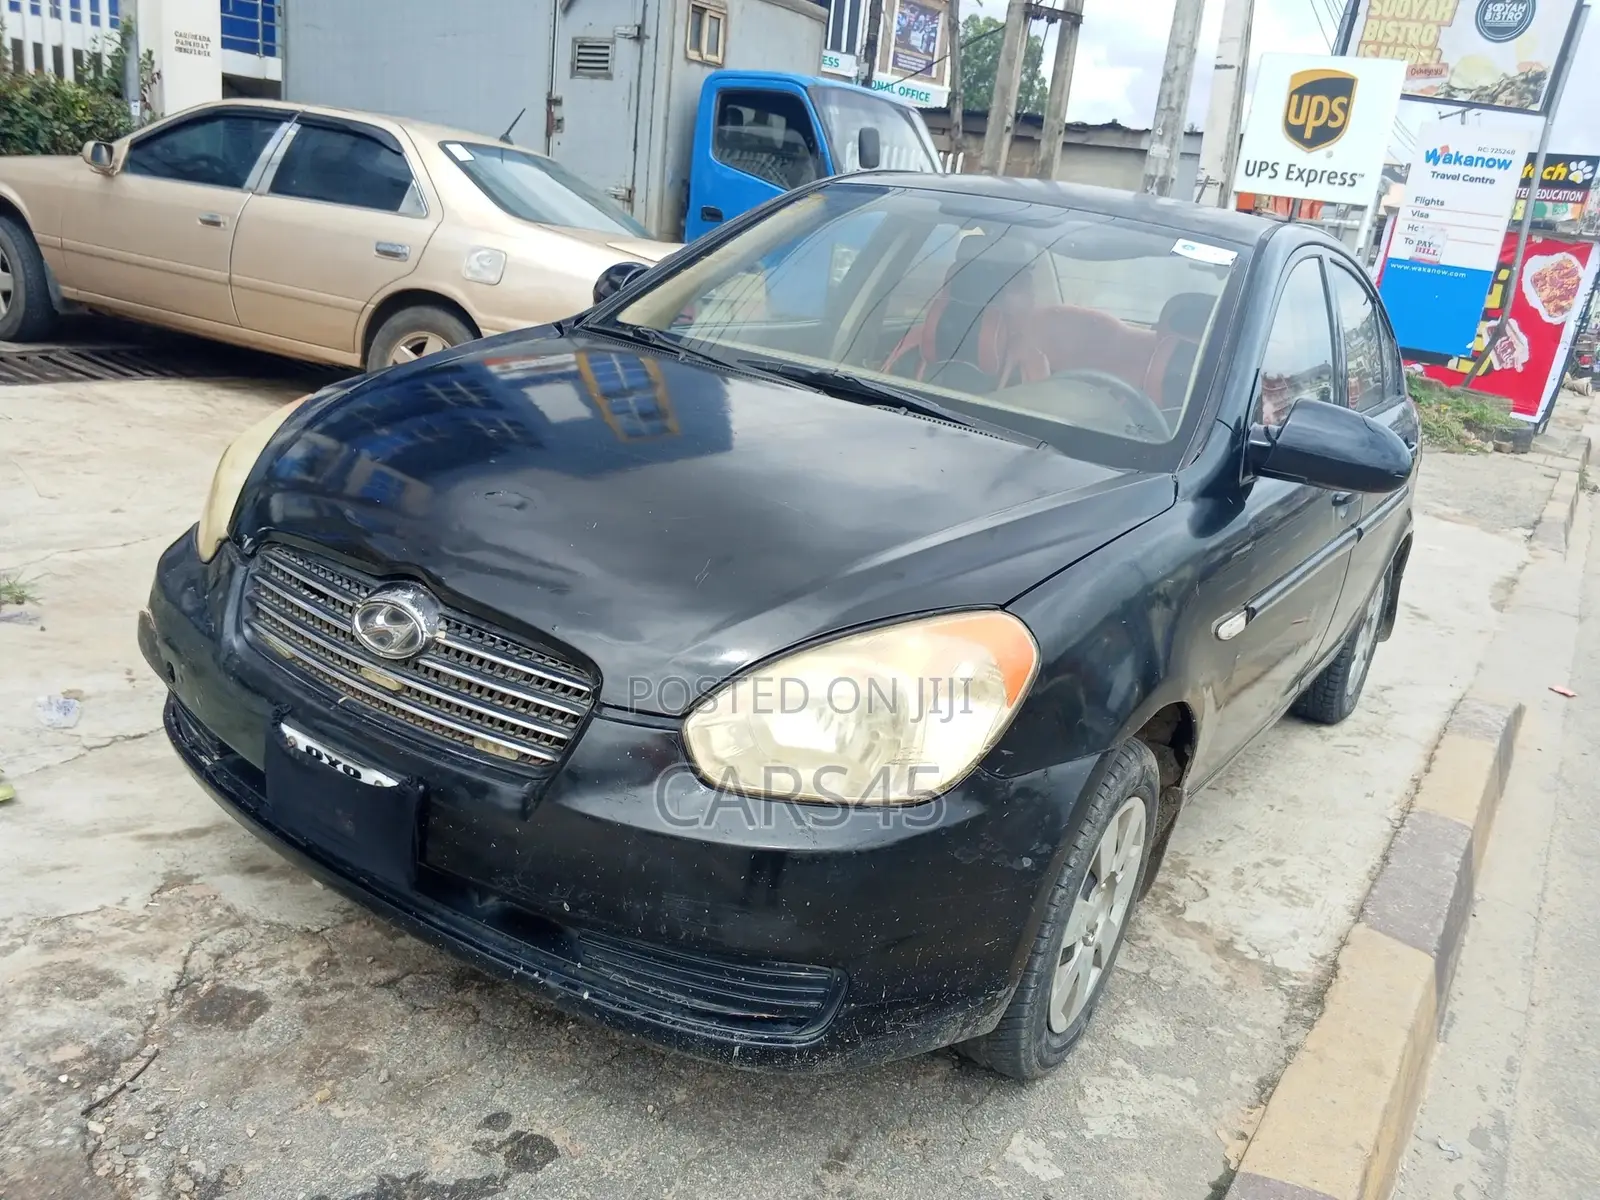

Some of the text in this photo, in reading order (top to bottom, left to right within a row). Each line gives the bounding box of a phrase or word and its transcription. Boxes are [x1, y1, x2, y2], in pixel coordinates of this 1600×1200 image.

[1484, 11, 1523, 21] BISTRO
[1363, 18, 1438, 47] BISTRO
[822, 55, 840, 68] ESS
[871, 79, 931, 103] ONAL OFFICE
[1287, 94, 1348, 139] ups
[1425, 146, 1513, 170] Wakanow
[1244, 159, 1280, 180] UPS
[1430, 170, 1496, 185] Travel Centre
[1414, 196, 1445, 207] Flights
[1535, 188, 1584, 202] EDUCATION
[1411, 209, 1430, 219] Visa
[1417, 239, 1433, 248] PAY
[1390, 262, 1467, 277] www.wakanow.com
